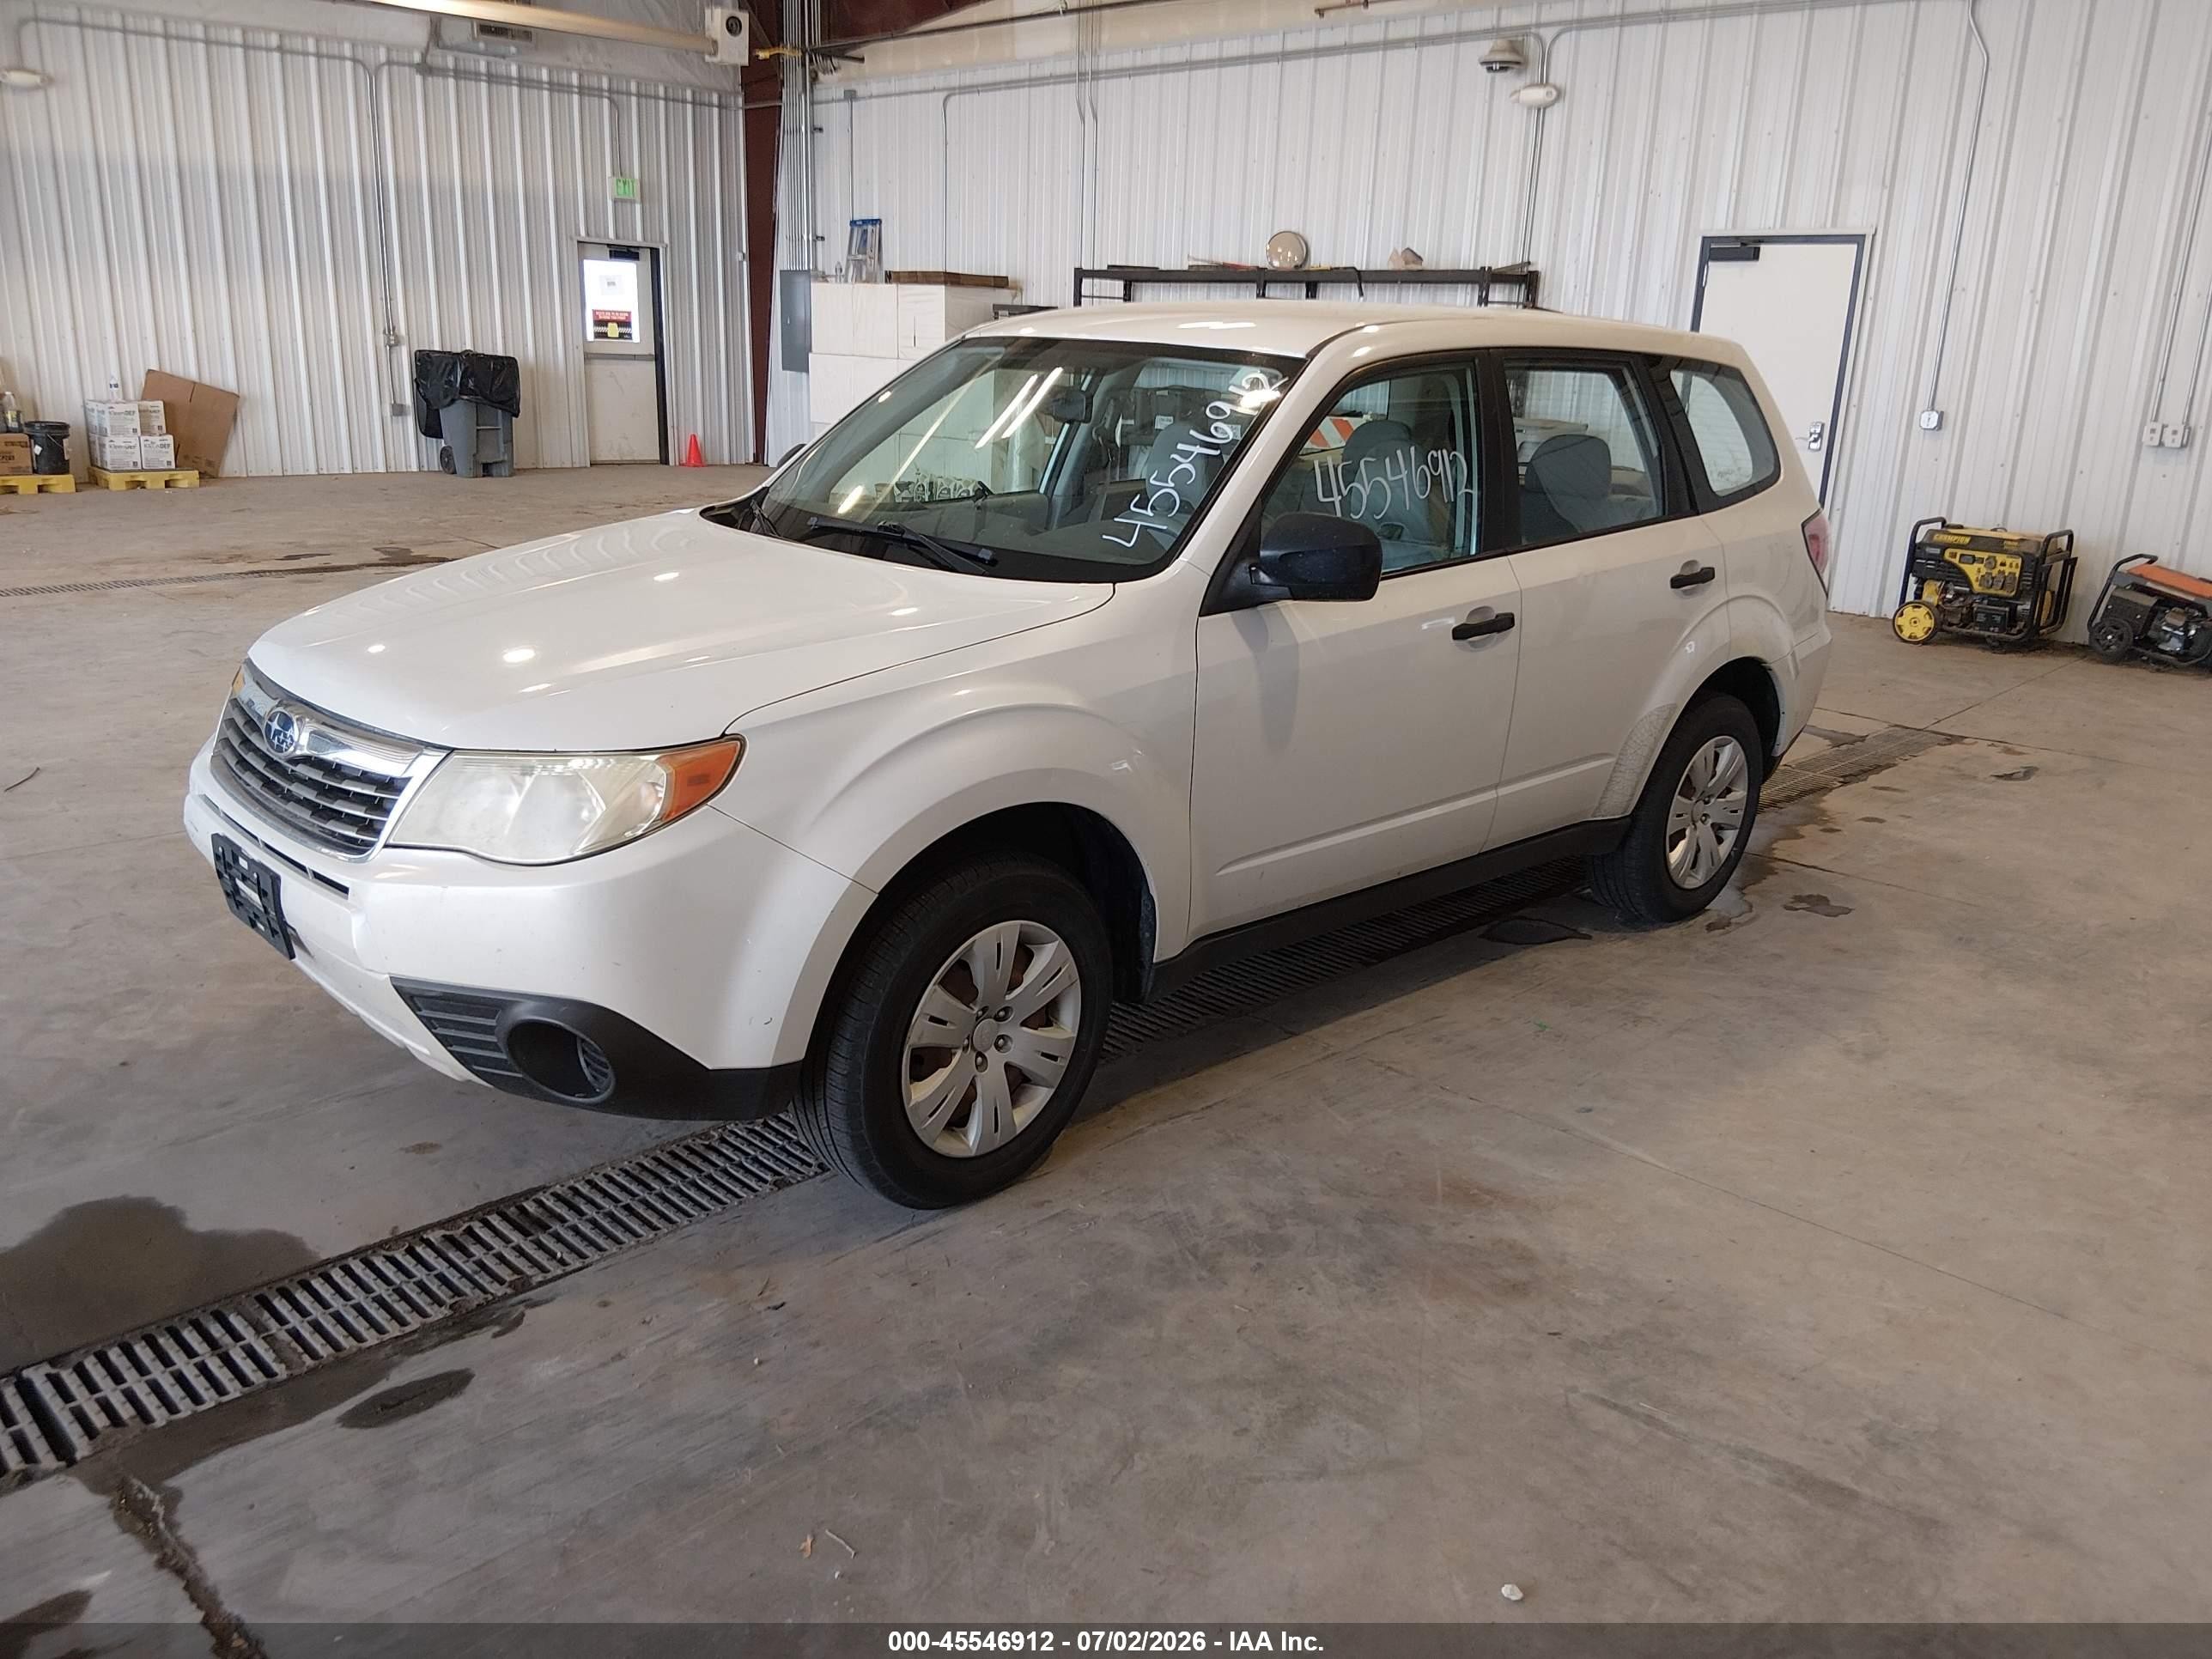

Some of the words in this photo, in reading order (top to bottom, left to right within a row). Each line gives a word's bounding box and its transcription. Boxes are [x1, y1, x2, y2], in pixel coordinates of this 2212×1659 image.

[616, 178, 635, 198] EXIT
[1313, 446, 1476, 520] 45546912
[1932, 533, 1971, 545] CHAMPION
